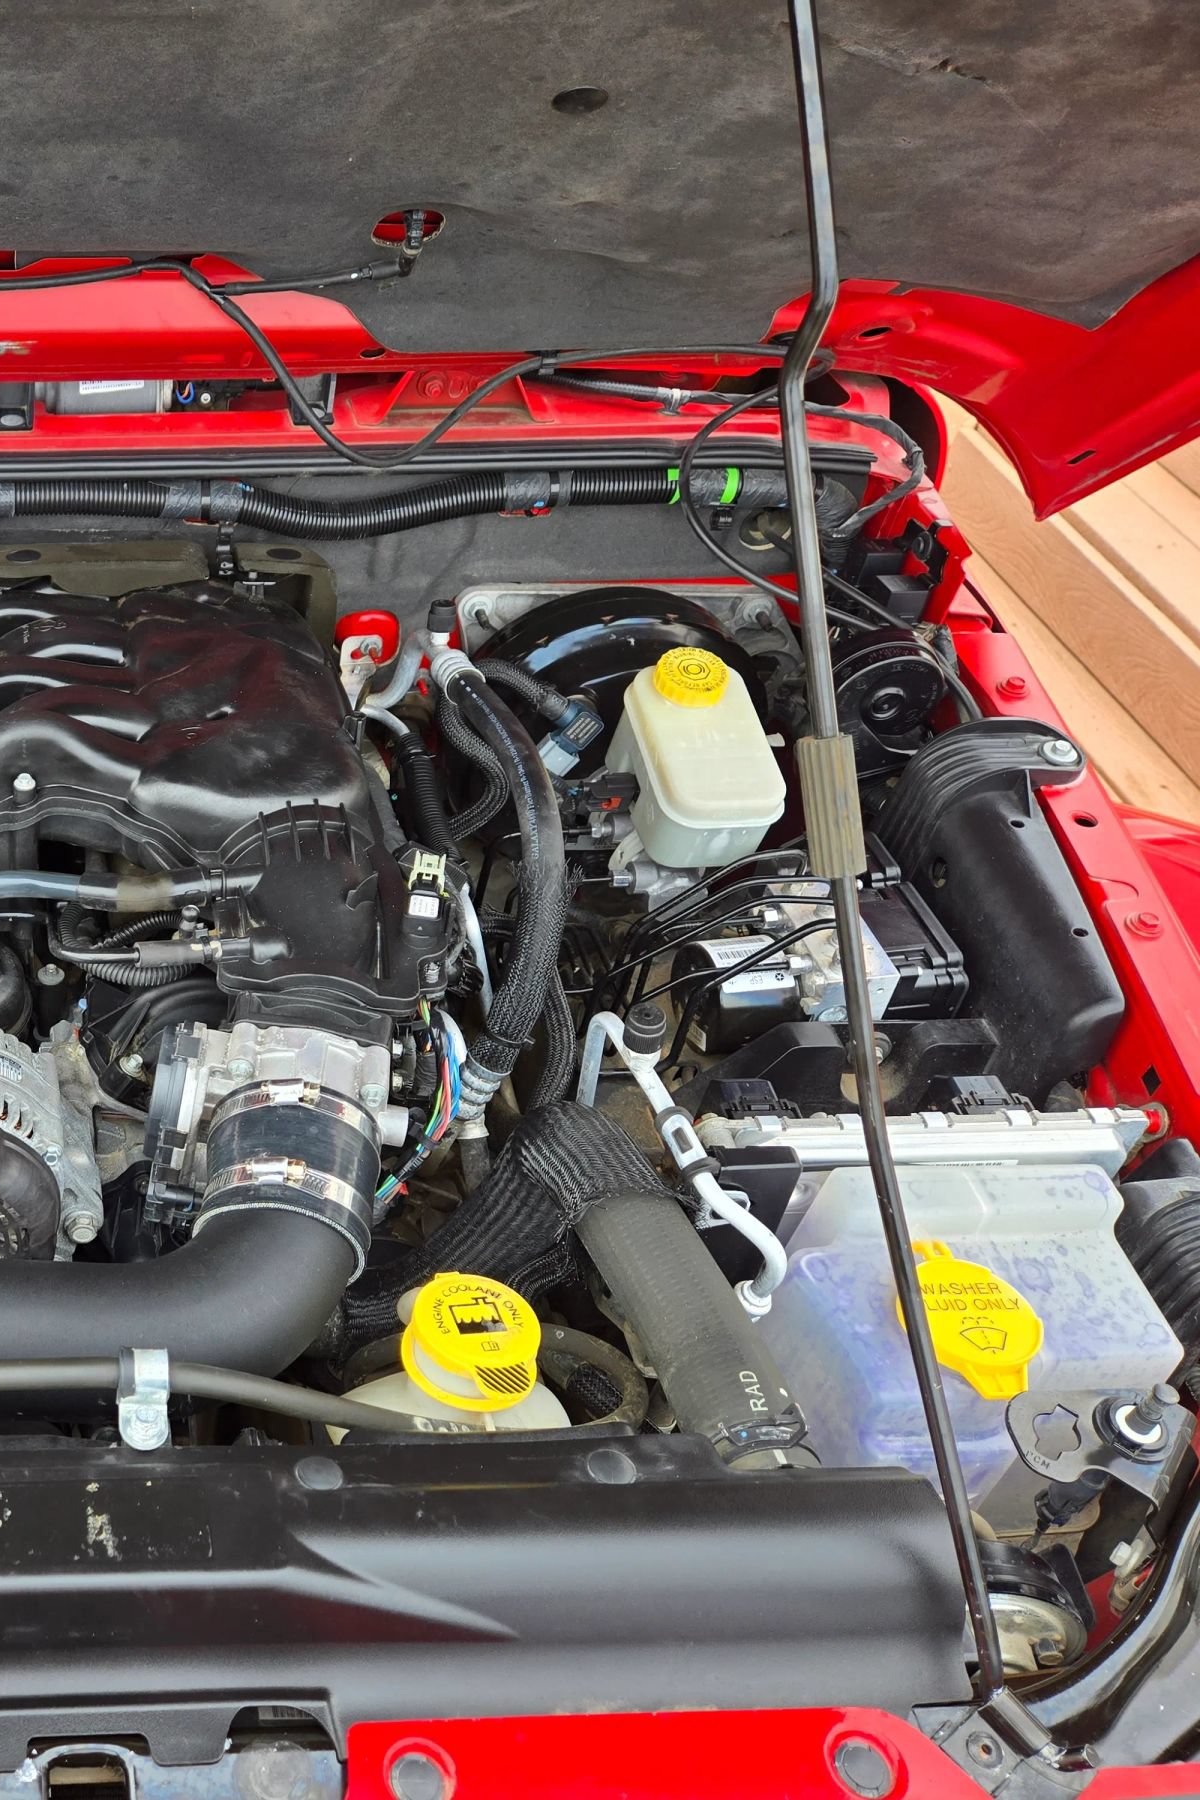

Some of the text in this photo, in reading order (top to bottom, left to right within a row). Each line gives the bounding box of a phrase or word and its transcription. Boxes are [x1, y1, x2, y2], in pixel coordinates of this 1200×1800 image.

[530, 825, 540, 860] GALAXY
[920, 1282, 1002, 1295] WASHER
[924, 1298, 1021, 1312] LUID ONLY
[432, 1284, 524, 1335] ENGINE COOLANT ONLY
[738, 1370, 768, 1412] RAD
